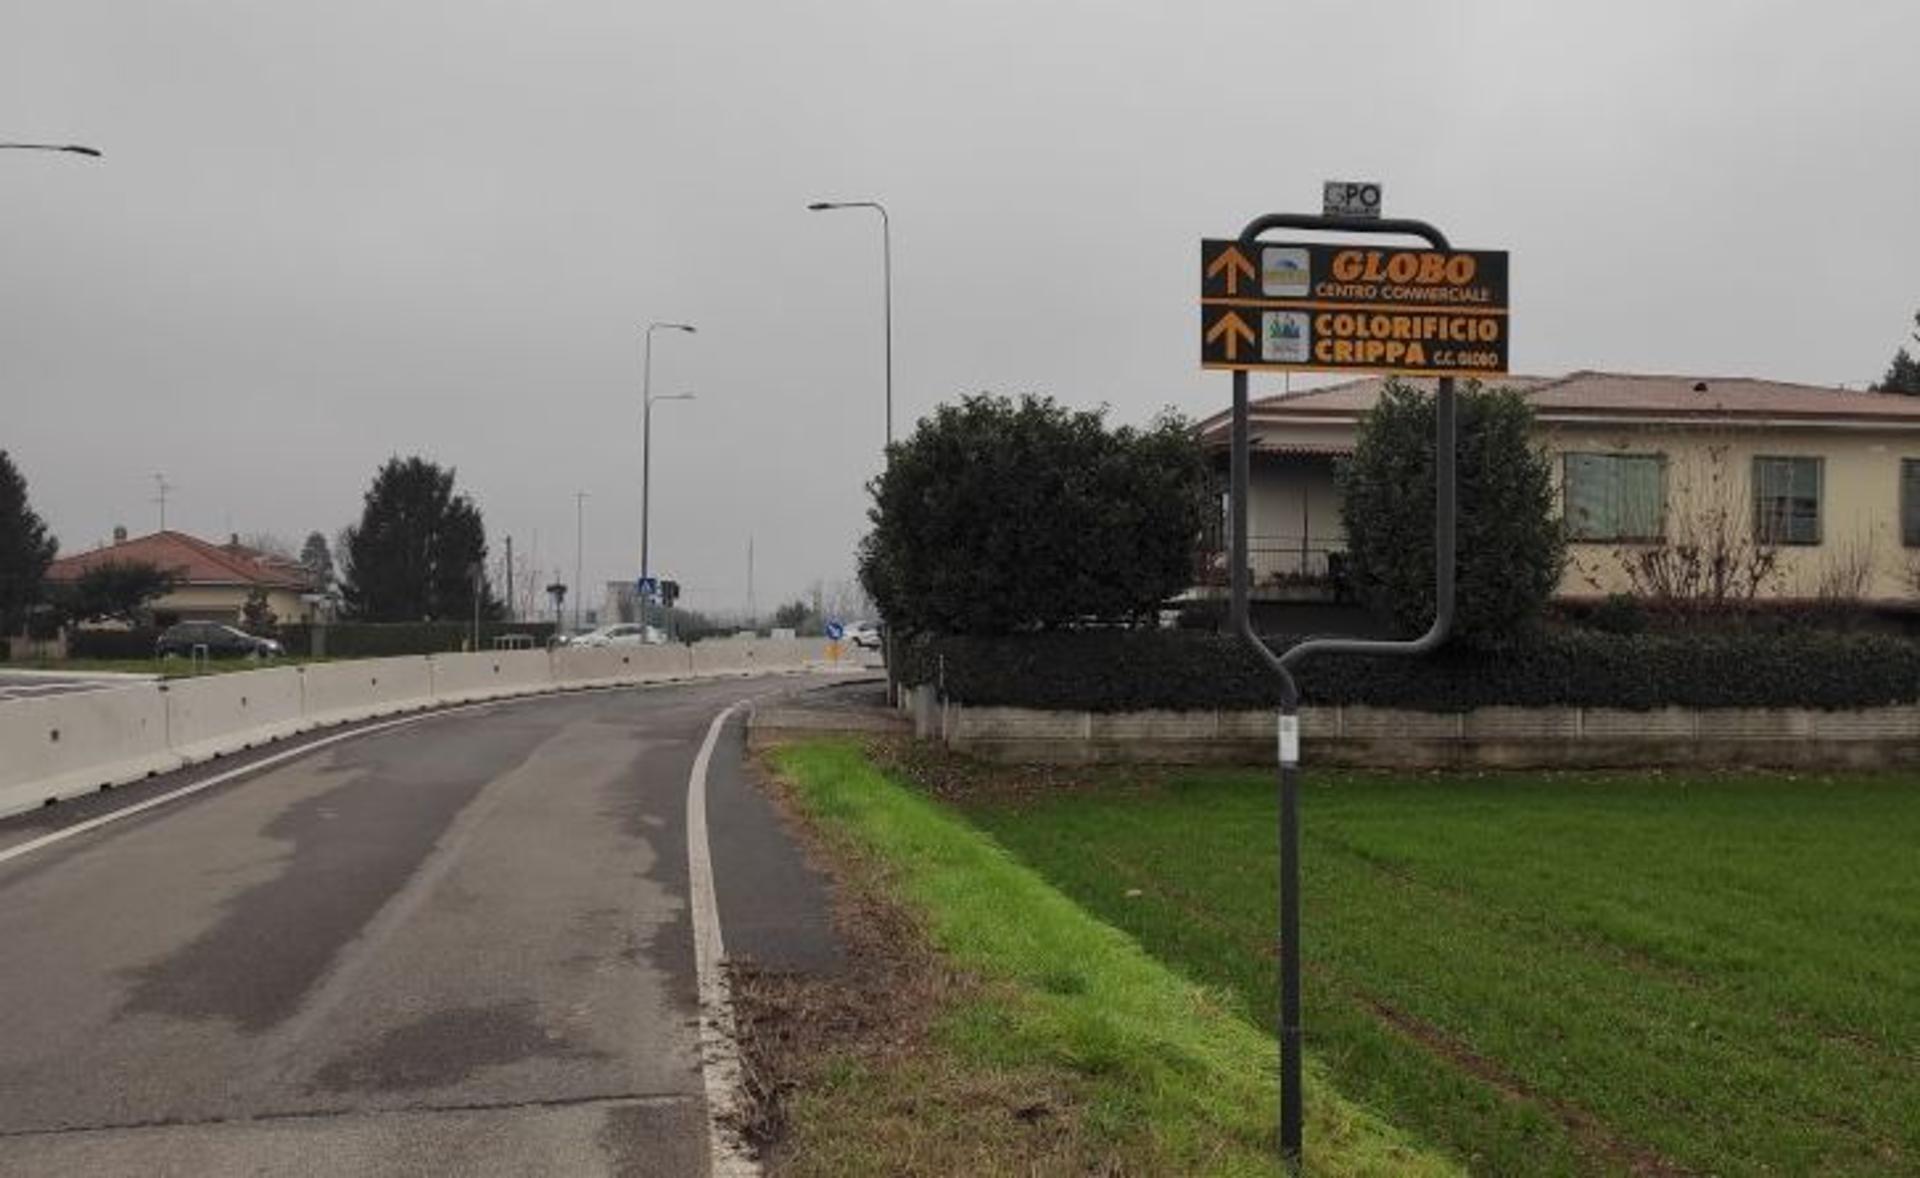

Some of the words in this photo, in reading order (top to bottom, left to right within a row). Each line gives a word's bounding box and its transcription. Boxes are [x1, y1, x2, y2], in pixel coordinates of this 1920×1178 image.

[1333, 250, 1476, 284] GLOBO
[1316, 282, 1377, 298] CENTRO
[1381, 285, 1491, 302] COMMERCIALE
[1315, 313, 1498, 340] COLORIFICIO
[1315, 339, 1427, 364] CRIPPA
